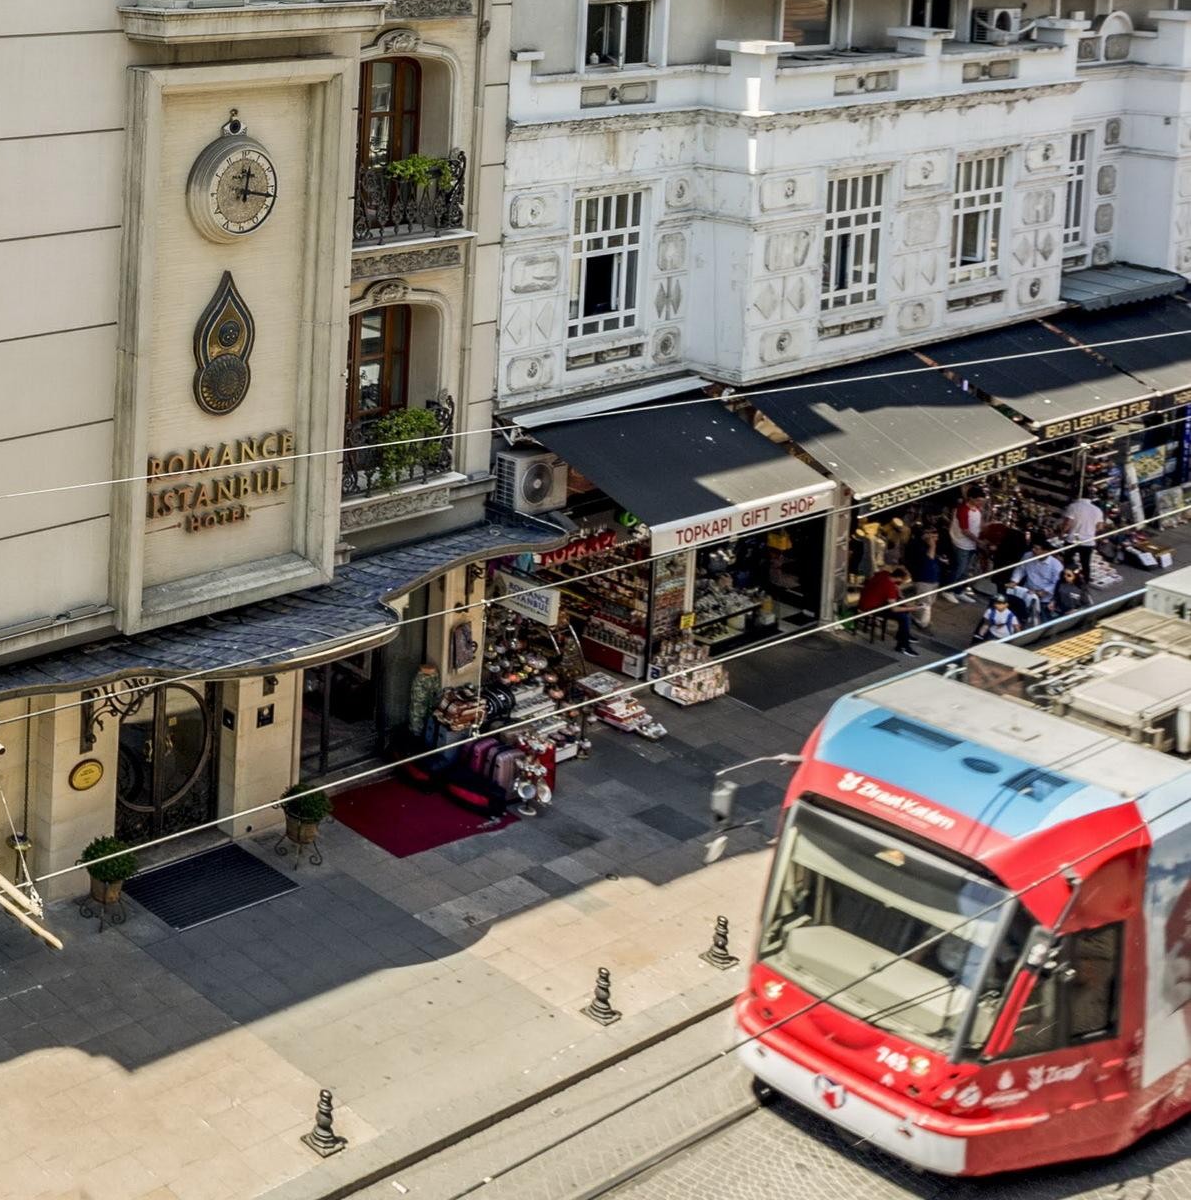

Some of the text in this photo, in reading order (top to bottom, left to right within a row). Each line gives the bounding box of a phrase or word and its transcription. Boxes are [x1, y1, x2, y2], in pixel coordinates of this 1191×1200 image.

[1073, 409, 1119, 430] LEATHER
[1129, 401, 1150, 414] FUR
[148, 431, 295, 482] ROMANCE
[946, 459, 993, 484] LEATHER
[1006, 448, 1027, 465] BAG
[147, 467, 288, 519] ISTANBUL
[676, 496, 815, 545] TOPKAPI GIFT SHOP
